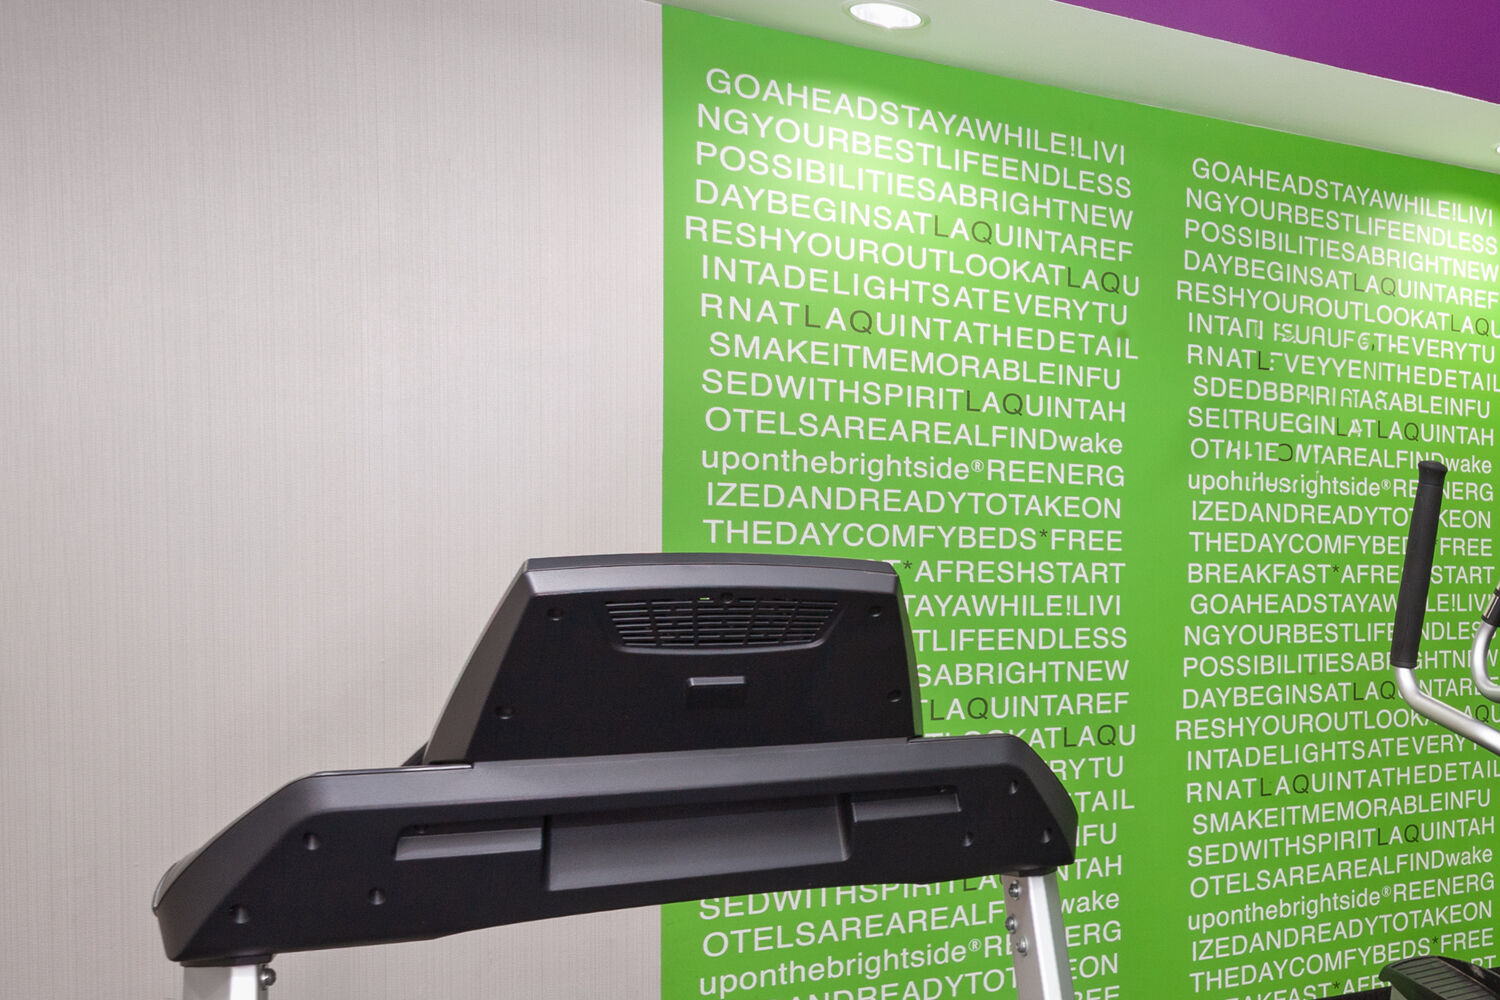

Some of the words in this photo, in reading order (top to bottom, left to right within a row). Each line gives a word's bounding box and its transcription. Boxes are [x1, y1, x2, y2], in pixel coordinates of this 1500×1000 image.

[697, 101, 1132, 199] NGYOURBESTLIFEENDLESS
[705, 65, 1125, 165] GOAHEADSTAYAWHILE!LIVI
[695, 139, 1134, 231] POSSIBILITIESABRIGHTNEW
[695, 176, 1134, 264] DAYBEGINSATLAQUINTAREF
[1191, 154, 1493, 230] GOAHEADSTAYAWHILE!LIVI
[684, 213, 1140, 297] RESHYOUROUTLOOKATLAQU
[1184, 216, 1499, 286] POSSIBILITIESABRIGHTNEW
[1185, 185, 1498, 259] NGYOURBESTLIFEENDLESS
[701, 253, 1128, 327] INTADELIGHTSATEVERYTU
[1183, 248, 1499, 314] DAYBEGINSATLAQUINTAREF
[700, 290, 1139, 361] RNATLAQUINTATHEDETAIL
[709, 329, 1121, 391] SMAKEITMEMORABLEINFU
[701, 366, 1126, 424] SEDWITHSPIRITLAQUINTAH
[704, 404, 1123, 456] OTELSAREAREALFINDwake
[706, 480, 1121, 521] IZEDANDREADYTOTAKEON
[1187, 816, 1495, 870] SEDWITHSPIRITLAQUINTAH
[1192, 789, 1491, 838] SMAKEITMEMORABLEINFU
[1189, 844, 1493, 901] OTELSAREAREALFINDwake
[1191, 899, 1493, 964] IZEDANDREADYTOTAKEON
